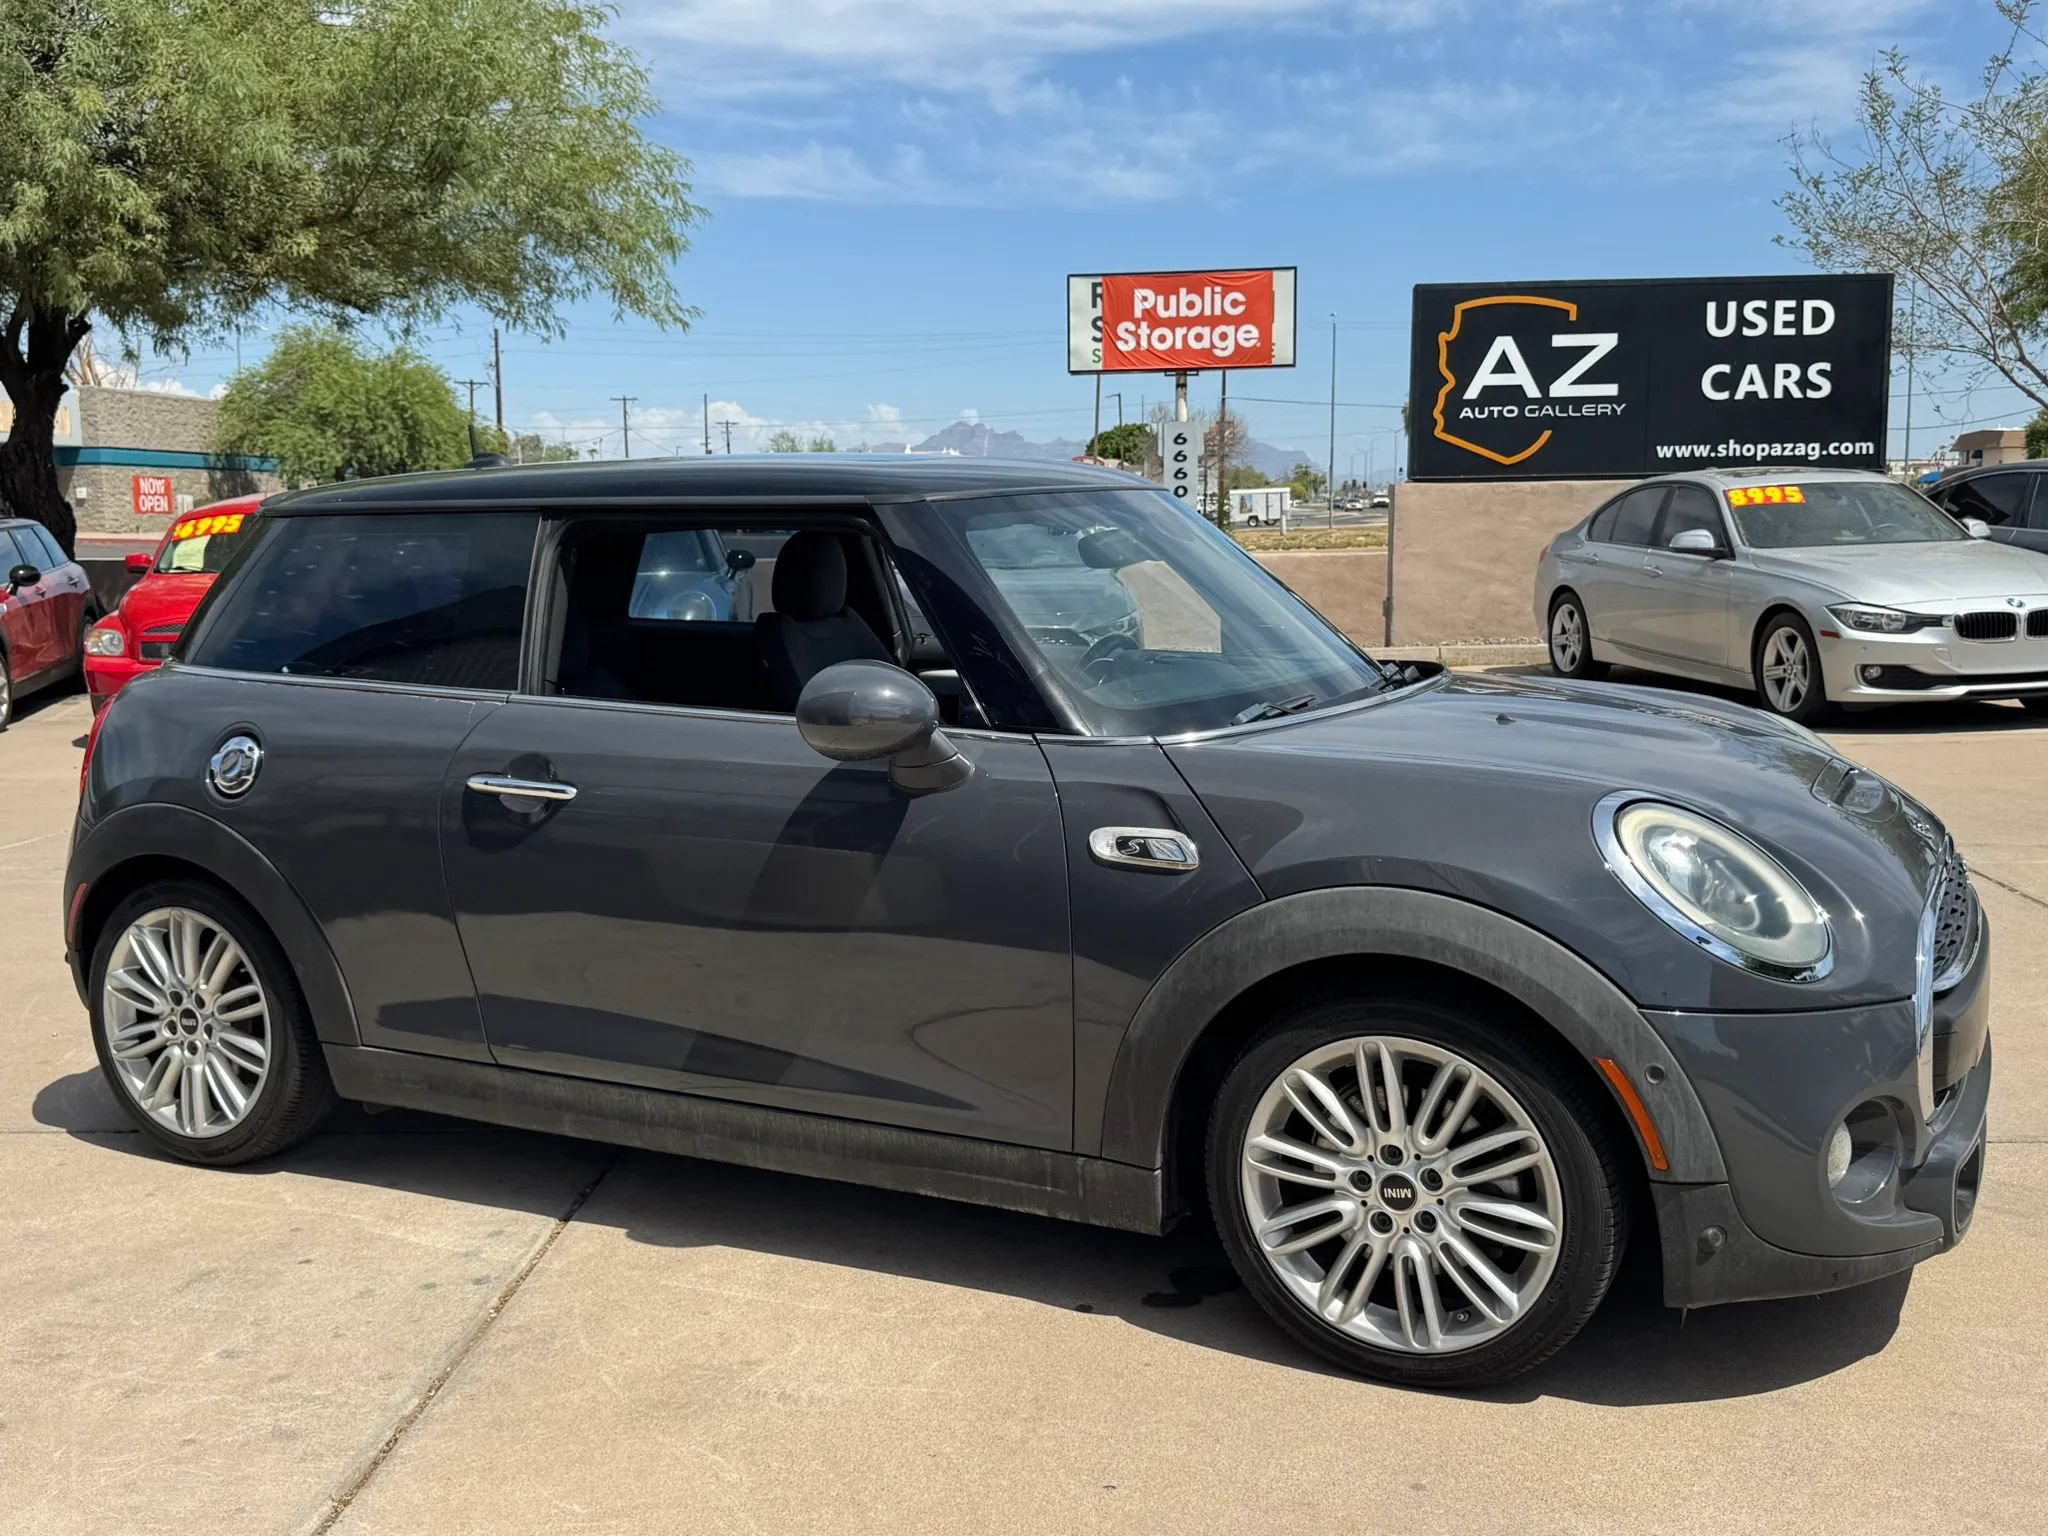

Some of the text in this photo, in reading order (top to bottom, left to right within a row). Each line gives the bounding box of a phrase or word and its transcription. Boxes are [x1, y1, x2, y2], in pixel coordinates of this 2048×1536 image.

[1134, 287, 1246, 318] Public
[1706, 300, 1836, 337] USED
[1462, 333, 1619, 400] AZ
[1701, 362, 1833, 400] CARS
[1459, 403, 1627, 419] AUTO GALLERY
[1656, 439, 1875, 461] www.shopazag.com
[139, 478, 165, 494] NOW
[1728, 486, 1804, 506] 8995
[139, 495, 168, 511] OPEN
[1383, 1187, 1412, 1199] MINI
